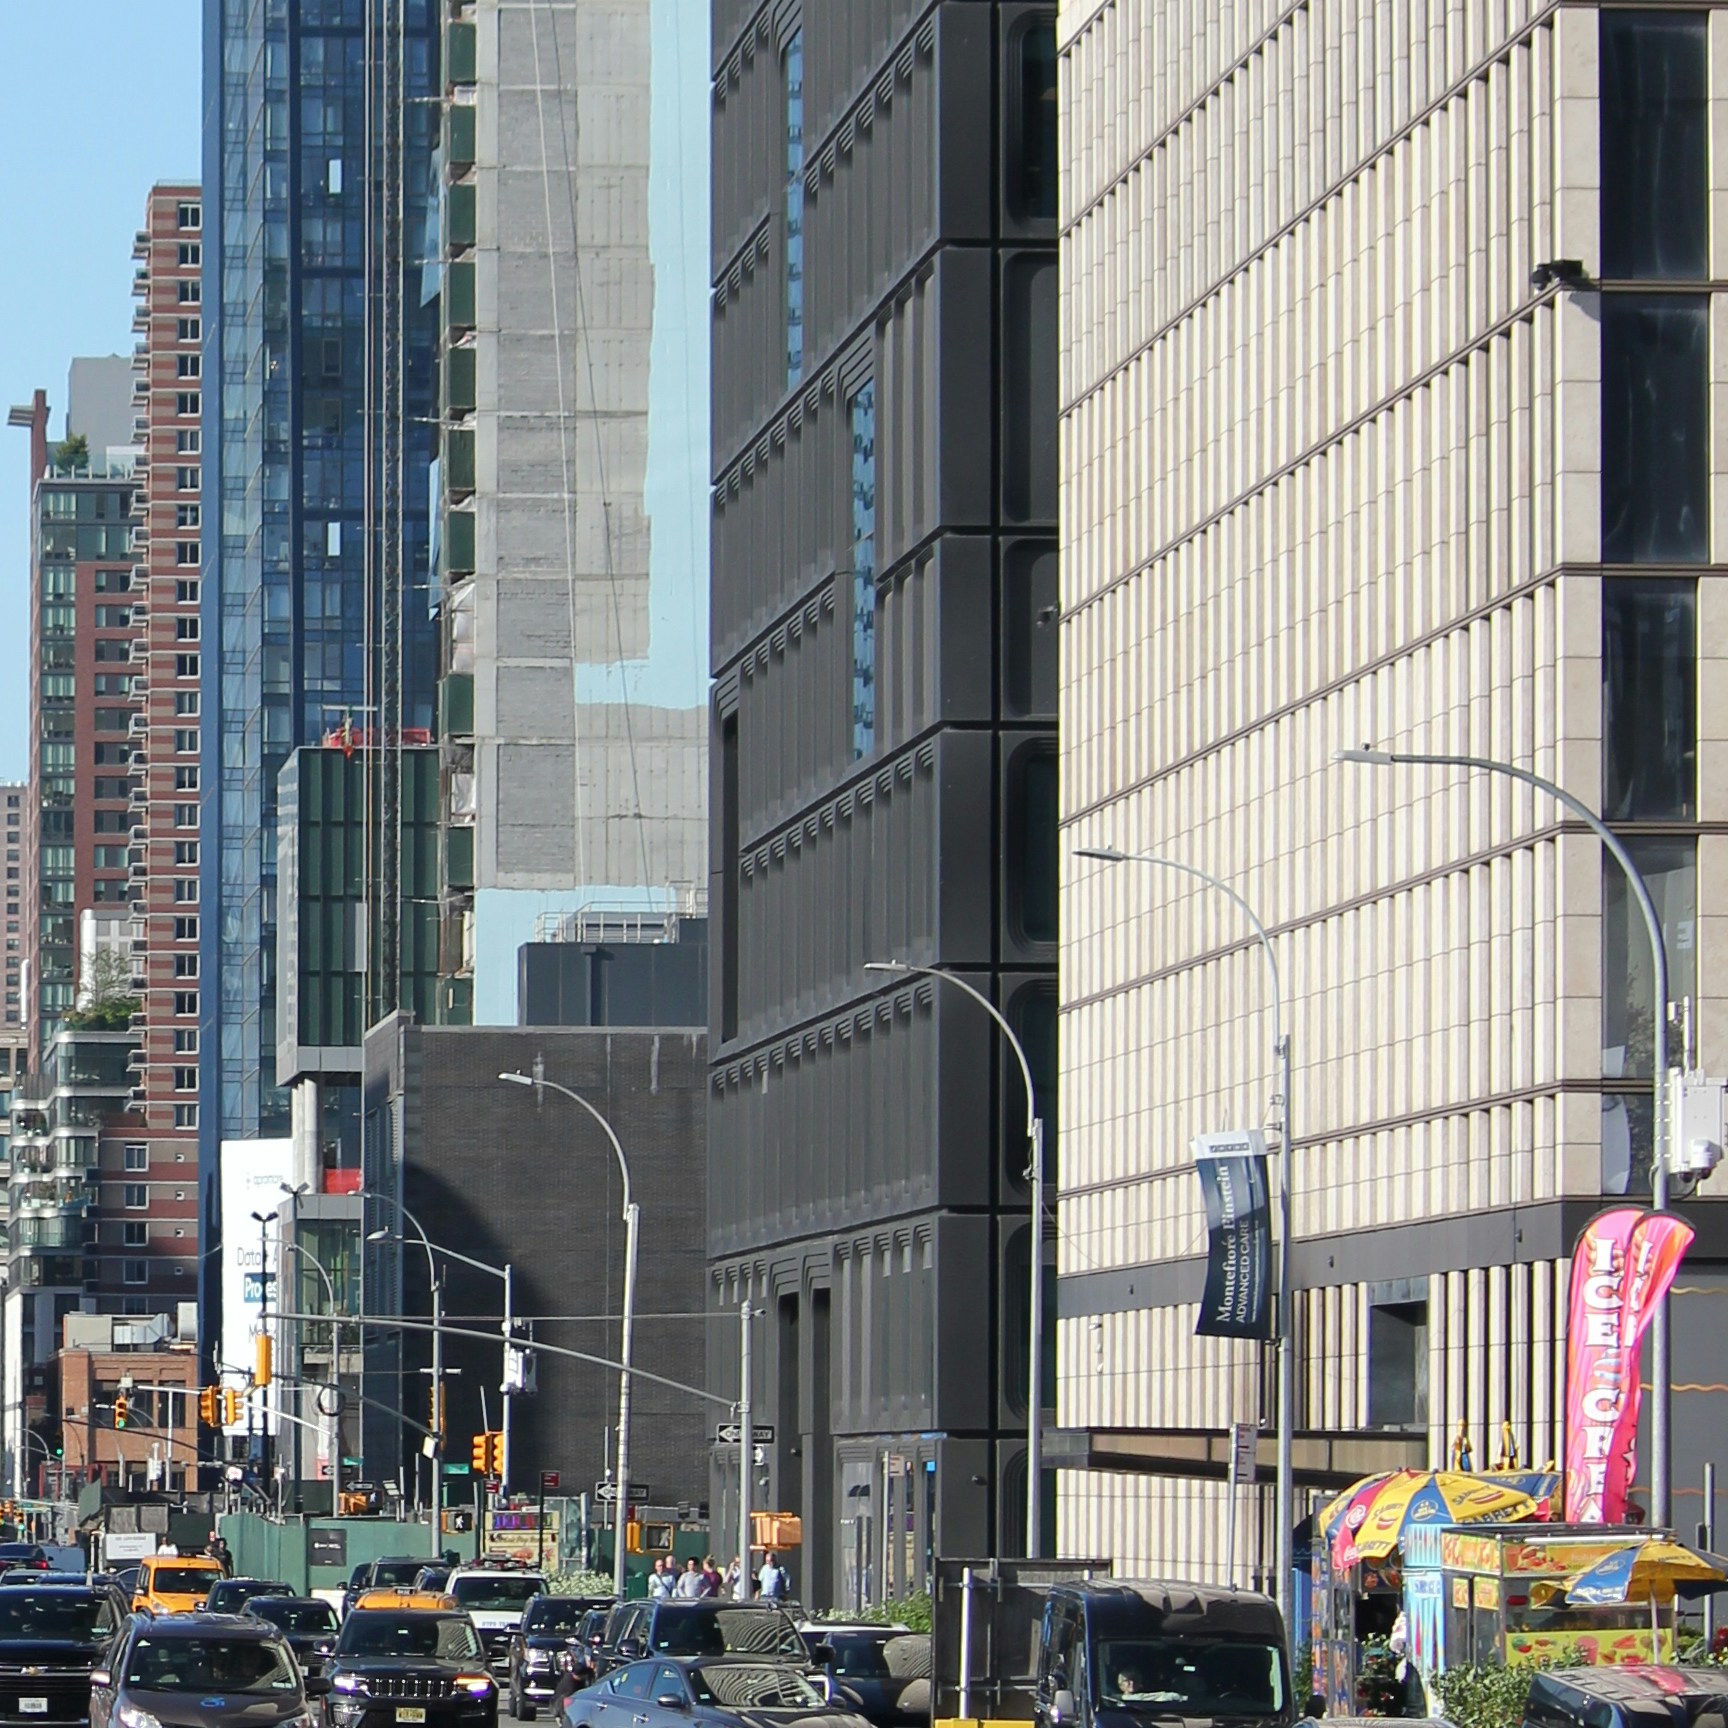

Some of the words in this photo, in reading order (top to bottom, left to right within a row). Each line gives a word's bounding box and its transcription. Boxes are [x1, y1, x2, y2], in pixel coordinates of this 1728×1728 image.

[1217, 1165, 1236, 1231] Einstein
[237, 1247, 262, 1266] Data
[1239, 1221, 1250, 1255] CARE
[1216, 1235, 1237, 1322] Montefiore
[1236, 1256, 1250, 1323] ADVANCED
[1583, 1237, 1624, 1349] ICE
[725, 1429, 742, 1439] ON
